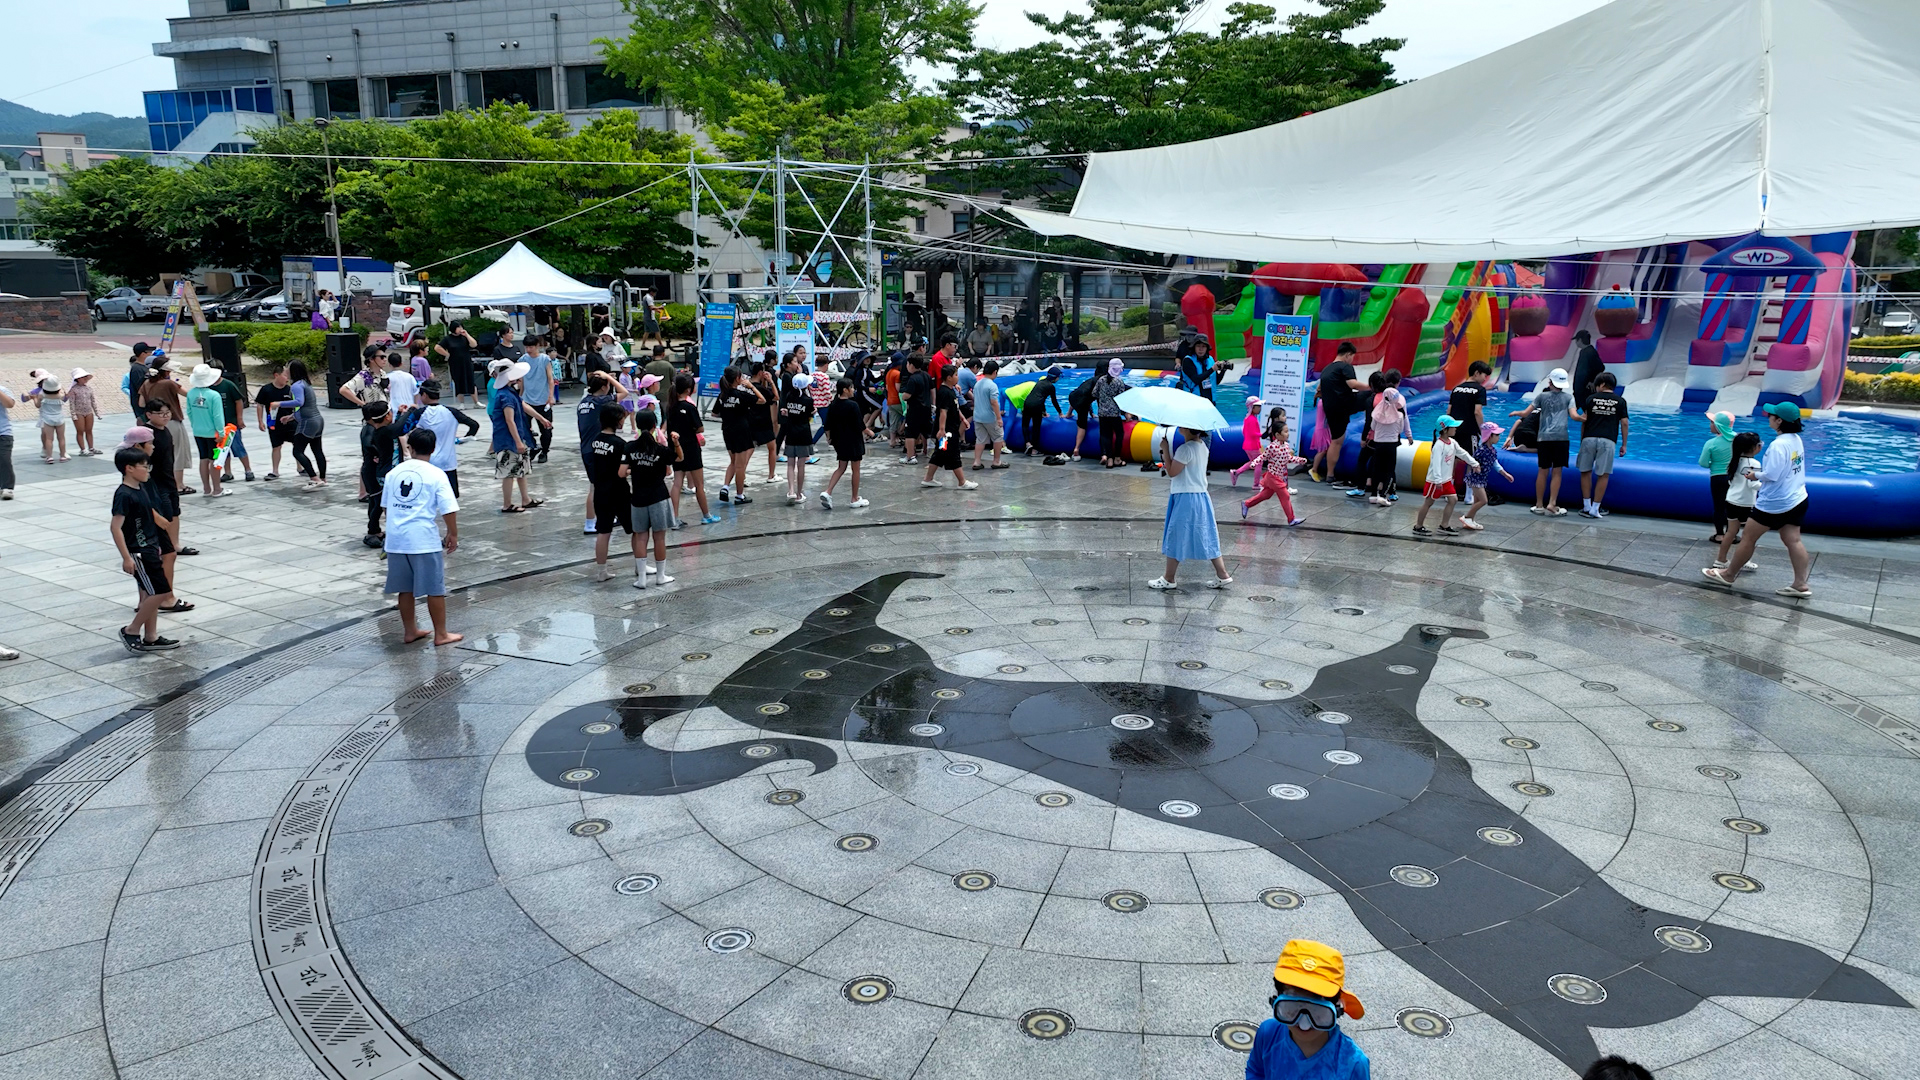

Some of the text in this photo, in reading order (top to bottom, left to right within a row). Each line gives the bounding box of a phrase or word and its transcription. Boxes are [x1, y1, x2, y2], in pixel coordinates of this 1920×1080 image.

[1747, 251, 1774, 263] WD
[776, 312, 812, 321] 에이바운스
[781, 321, 808, 330] 안전수칙
[1267, 323, 1308, 336] 에이바운스
[1271, 335, 1302, 347] 안전수칙
[594, 448, 608, 456] ARMY
[281, 866, 303, 882] 진도
[300, 965, 327, 986] 진도
